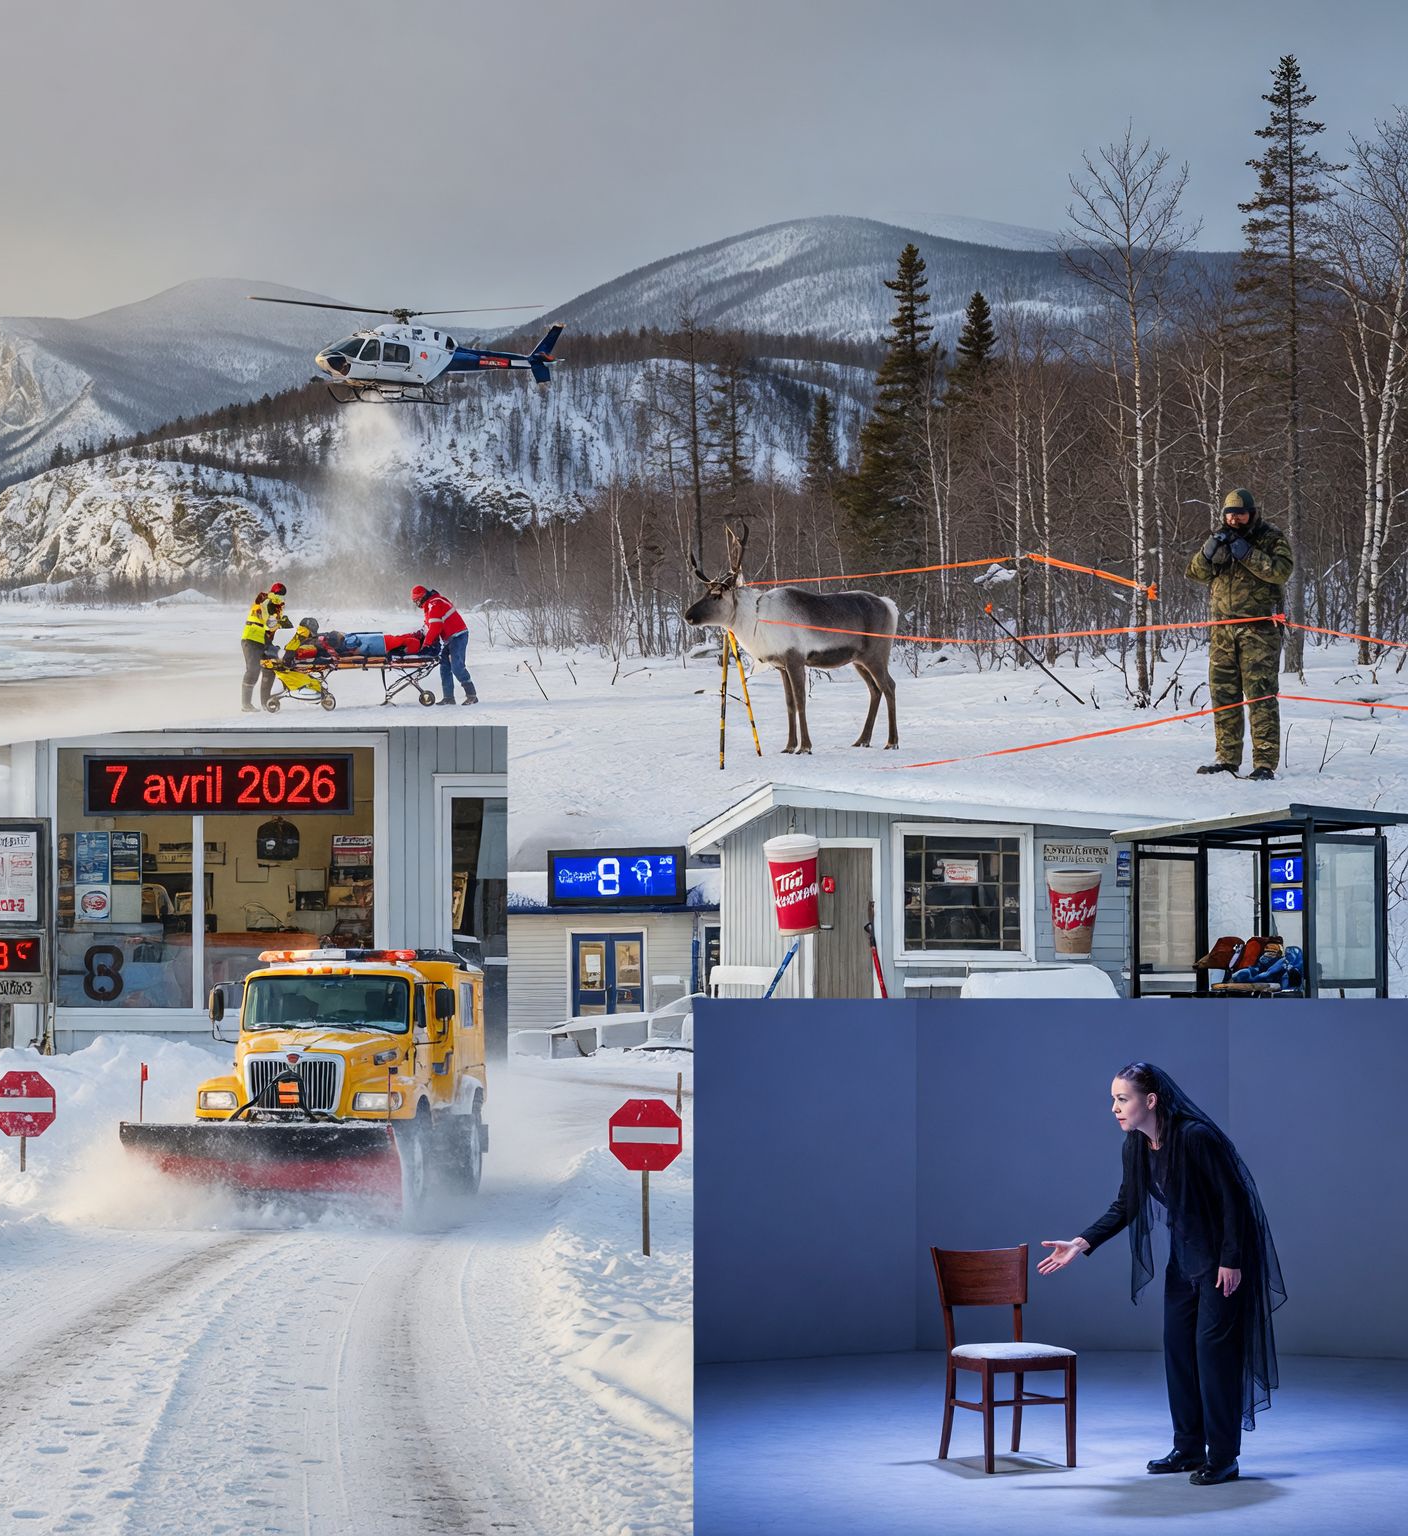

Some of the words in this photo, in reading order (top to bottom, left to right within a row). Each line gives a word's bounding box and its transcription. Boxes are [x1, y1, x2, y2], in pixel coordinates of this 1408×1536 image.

[105, 765, 128, 804] 7
[143, 765, 223, 804] avril
[237, 764, 336, 804] 2026
